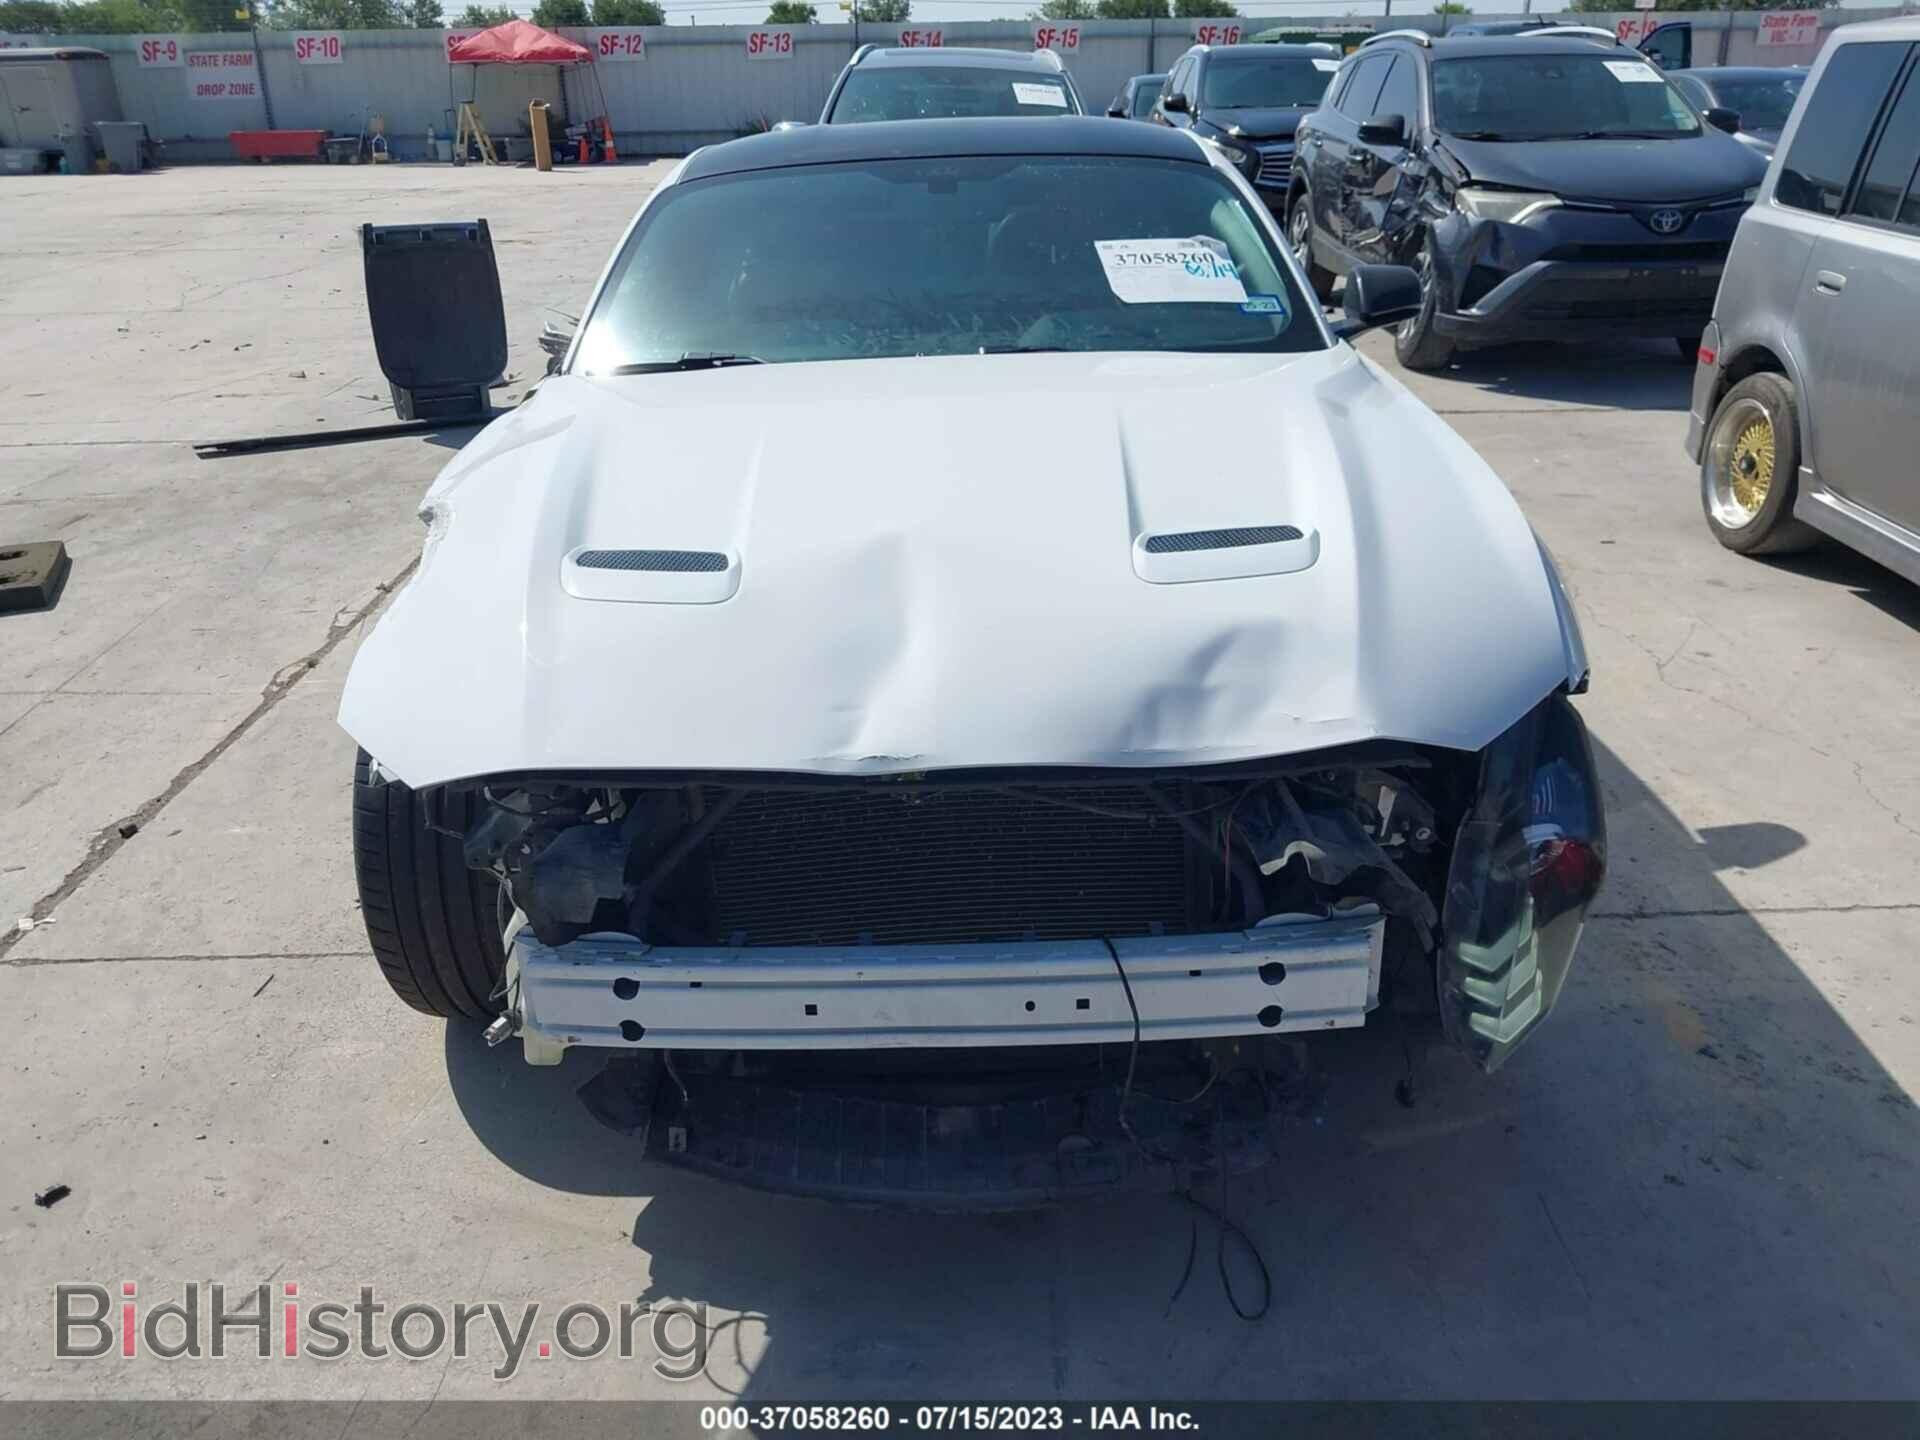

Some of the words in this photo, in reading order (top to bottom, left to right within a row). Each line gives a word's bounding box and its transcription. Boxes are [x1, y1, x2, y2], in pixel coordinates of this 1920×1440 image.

[600, 34, 642, 56] SF-12
[749, 32, 791, 53] SF-13
[900, 31, 942, 48] SF-14
[1035, 27, 1079, 49] SF-15
[1197, 25, 1241, 45] SF-16
[141, 40, 177, 62] SF-9
[296, 37, 338, 59] SF-10
[188, 54, 221, 68] STATE
[223, 52, 254, 67] FARM
[196, 82, 226, 97] DROP
[229, 82, 257, 96] ZONE
[1114, 251, 1216, 266] 37058260
